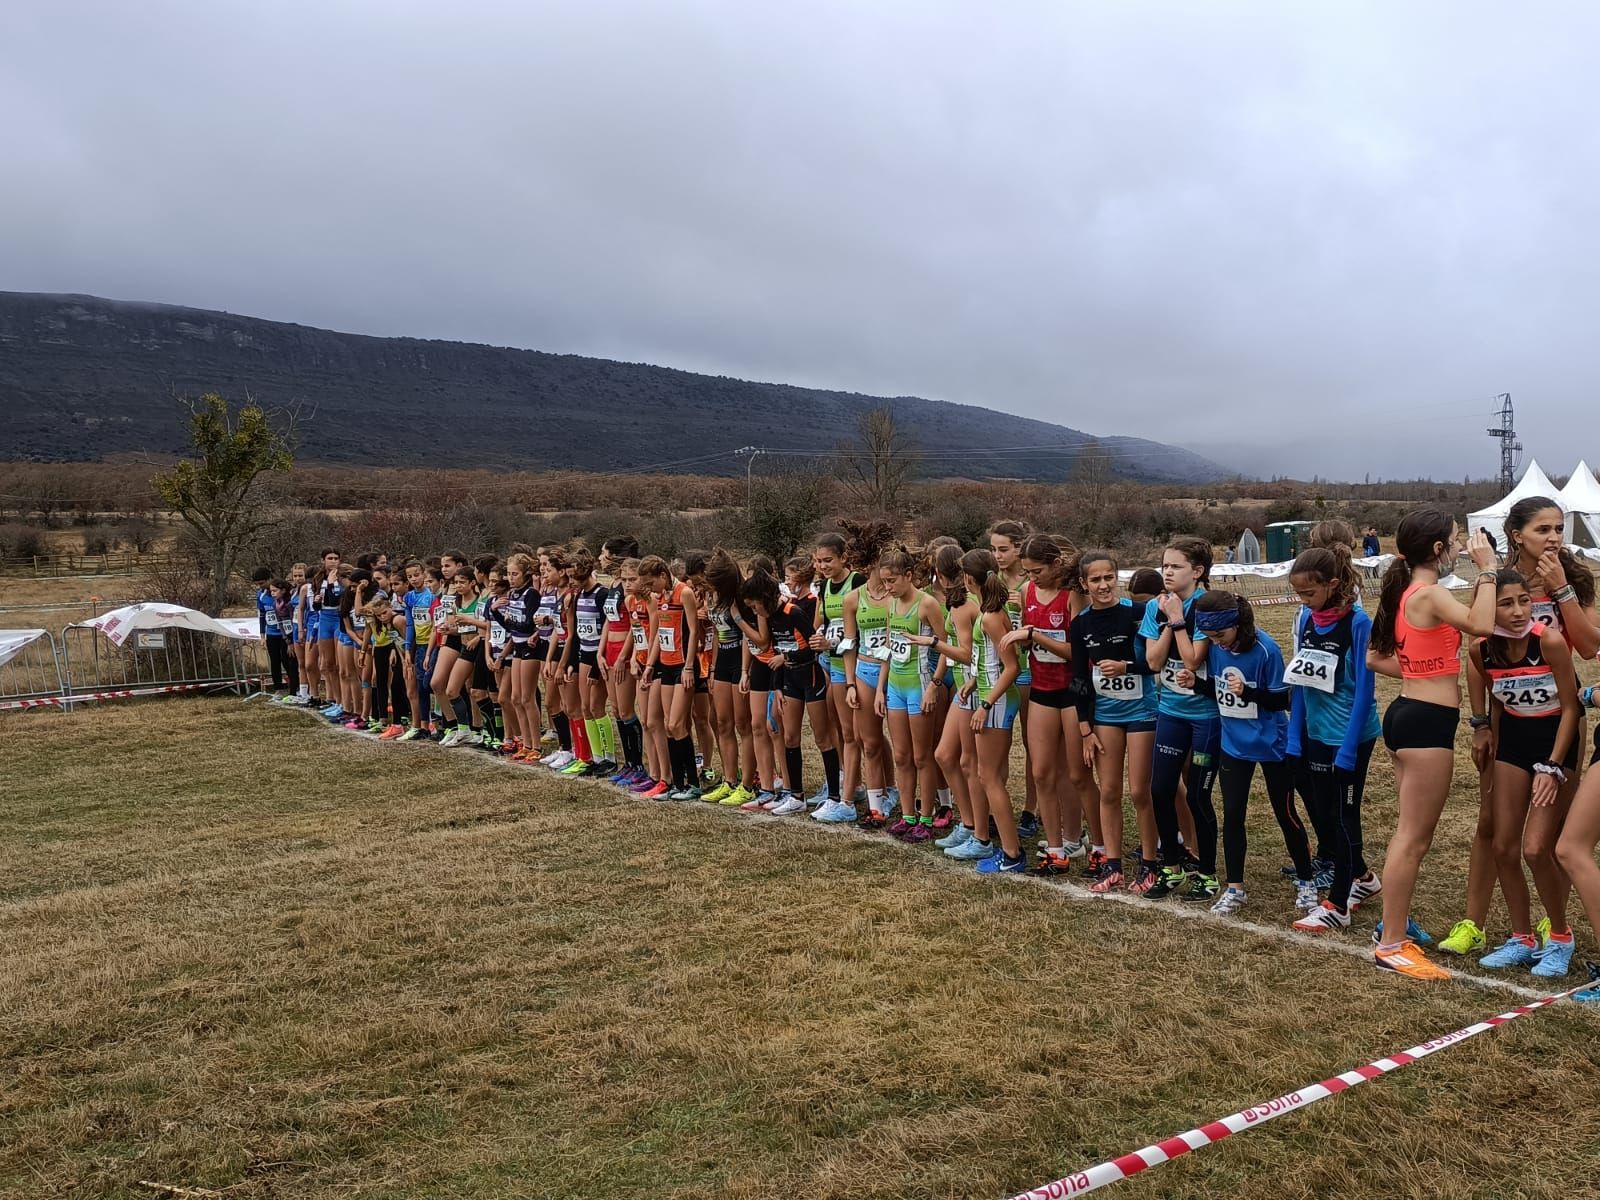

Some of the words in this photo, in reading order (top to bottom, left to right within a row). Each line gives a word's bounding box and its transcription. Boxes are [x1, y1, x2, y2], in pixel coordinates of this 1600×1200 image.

[578, 624, 594, 634] 239
[722, 642, 738, 650] NIKE
[1167, 659, 1176, 668] 27
[1399, 654, 1445, 673] Runners
[1290, 659, 1328, 681] 284
[1099, 677, 1136, 691] 286
[1503, 680, 1516, 689] 27
[1502, 688, 1551, 706] 243
